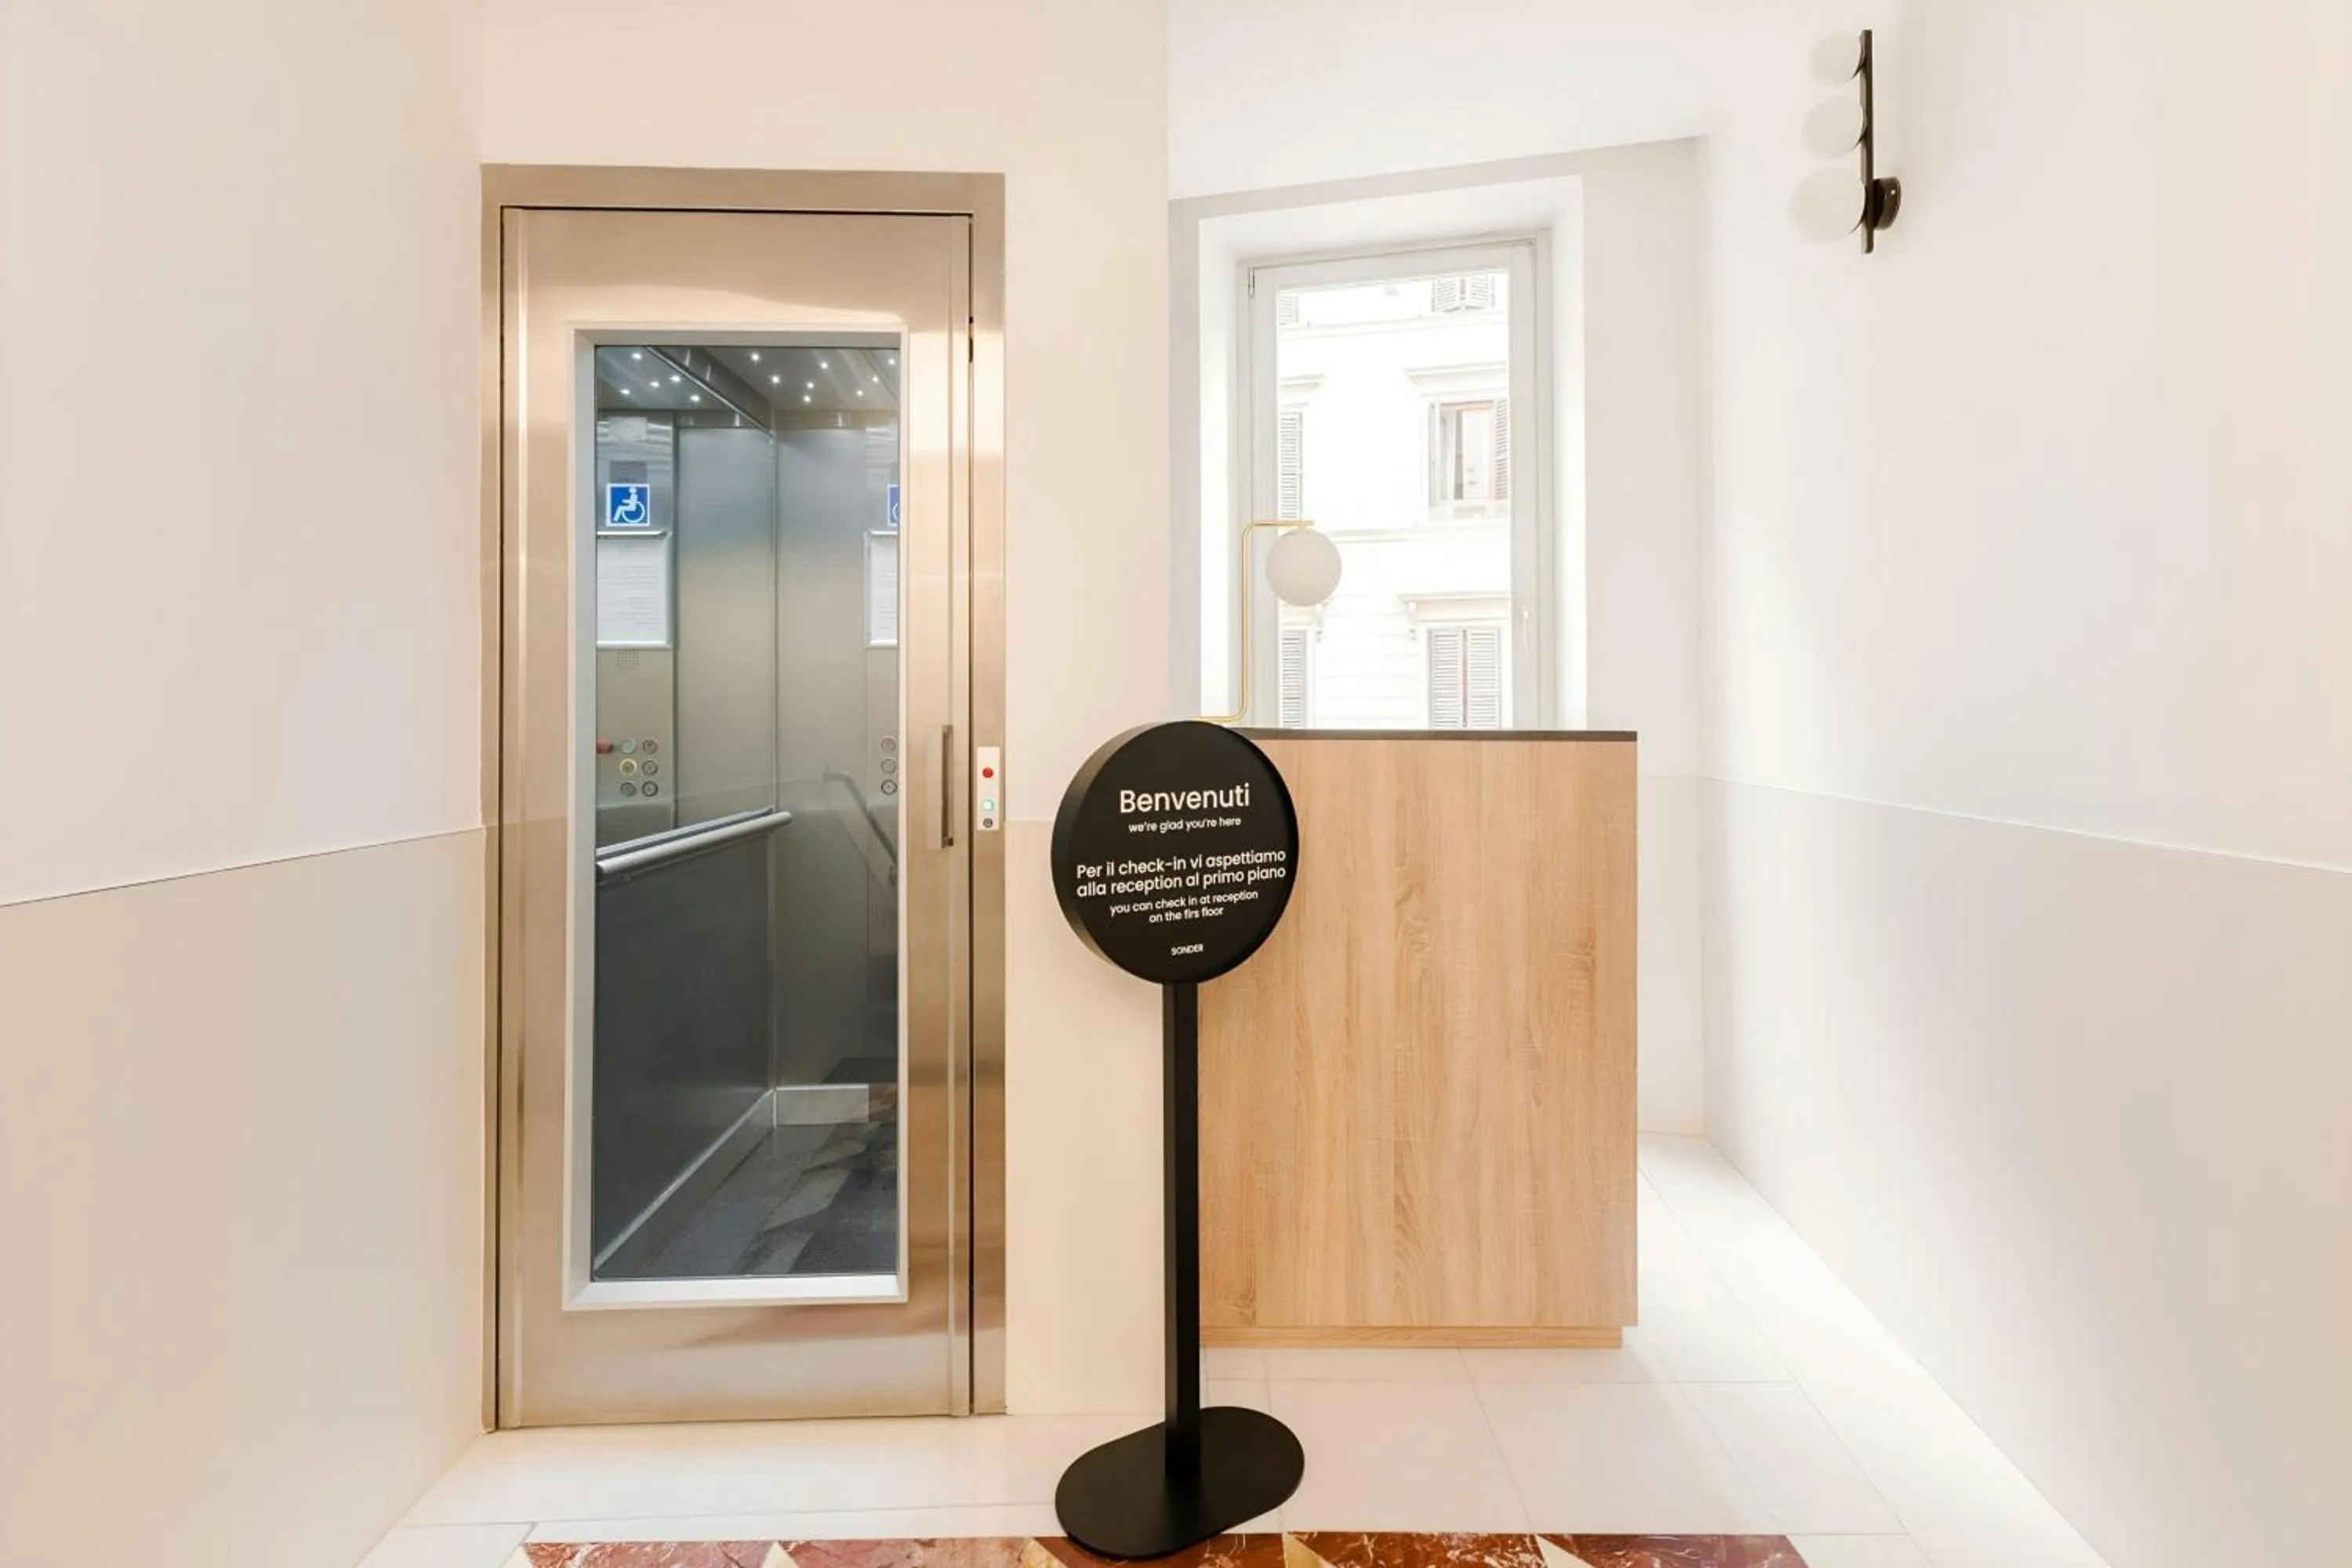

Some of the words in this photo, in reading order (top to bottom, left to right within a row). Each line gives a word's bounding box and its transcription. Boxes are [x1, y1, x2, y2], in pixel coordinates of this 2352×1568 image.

[1120, 782, 1249, 813] Benvenuti
[1129, 822, 1157, 833] we're
[1160, 819, 1183, 833] glad
[1185, 818, 1217, 831] you're
[1219, 817, 1241, 826] here
[1077, 865, 1102, 878] Per
[1107, 862, 1114, 876] il
[1119, 856, 1186, 874] check-in
[1190, 855, 1202, 869] vi
[1206, 850, 1286, 869] aspettiamo
[1077, 882, 1106, 897] alla
[1111, 875, 1182, 895] reception
[1186, 874, 1199, 886] al
[1203, 869, 1244, 889] primo
[1247, 866, 1286, 884] piano
[1110, 905, 1130, 916] you
[1133, 902, 1152, 911] can
[1156, 897, 1185, 909] check
[1189, 896, 1197, 906] in
[1200, 895, 1210, 905] at
[1213, 891, 1258, 903] reception
[1149, 914, 1162, 923] on
[1165, 911, 1181, 920] the
[1184, 909, 1200, 919] firs
[1202, 907, 1223, 916] floor
[1171, 944, 1203, 955] SONDER
